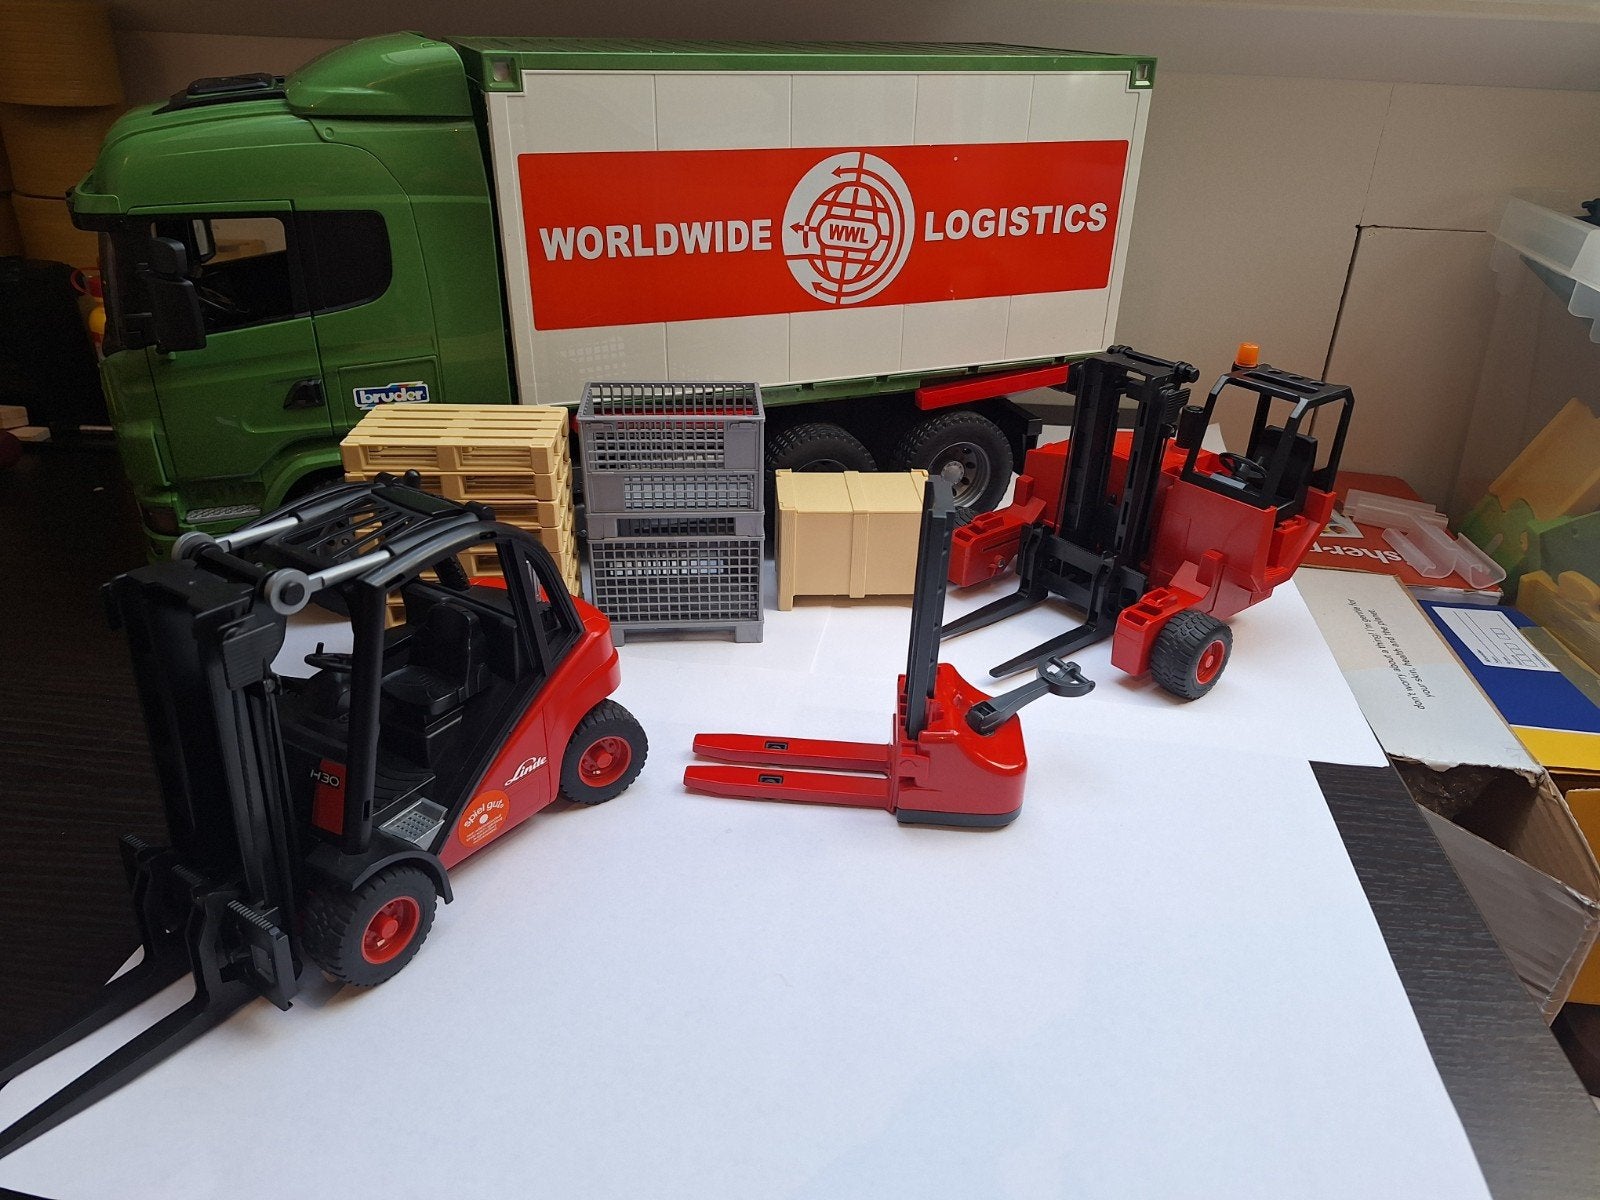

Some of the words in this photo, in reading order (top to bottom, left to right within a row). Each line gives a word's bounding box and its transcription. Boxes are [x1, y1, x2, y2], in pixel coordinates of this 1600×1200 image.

[539, 219, 772, 261] WORLDWIDE
[924, 202, 1108, 242] LOGISTICS
[828, 223, 869, 245] WWL
[359, 387, 424, 404] bruder
[1383, 637, 1399, 649] and
[1383, 655, 1401, 671] about
[1393, 648, 1412, 667] health
[1397, 674, 1414, 691] worry
[1408, 668, 1423, 682] skin,
[1417, 682, 1436, 698] your
[1407, 692, 1425, 710] don't
[504, 756, 547, 787] Linde
[463, 803, 486, 828] spiel
